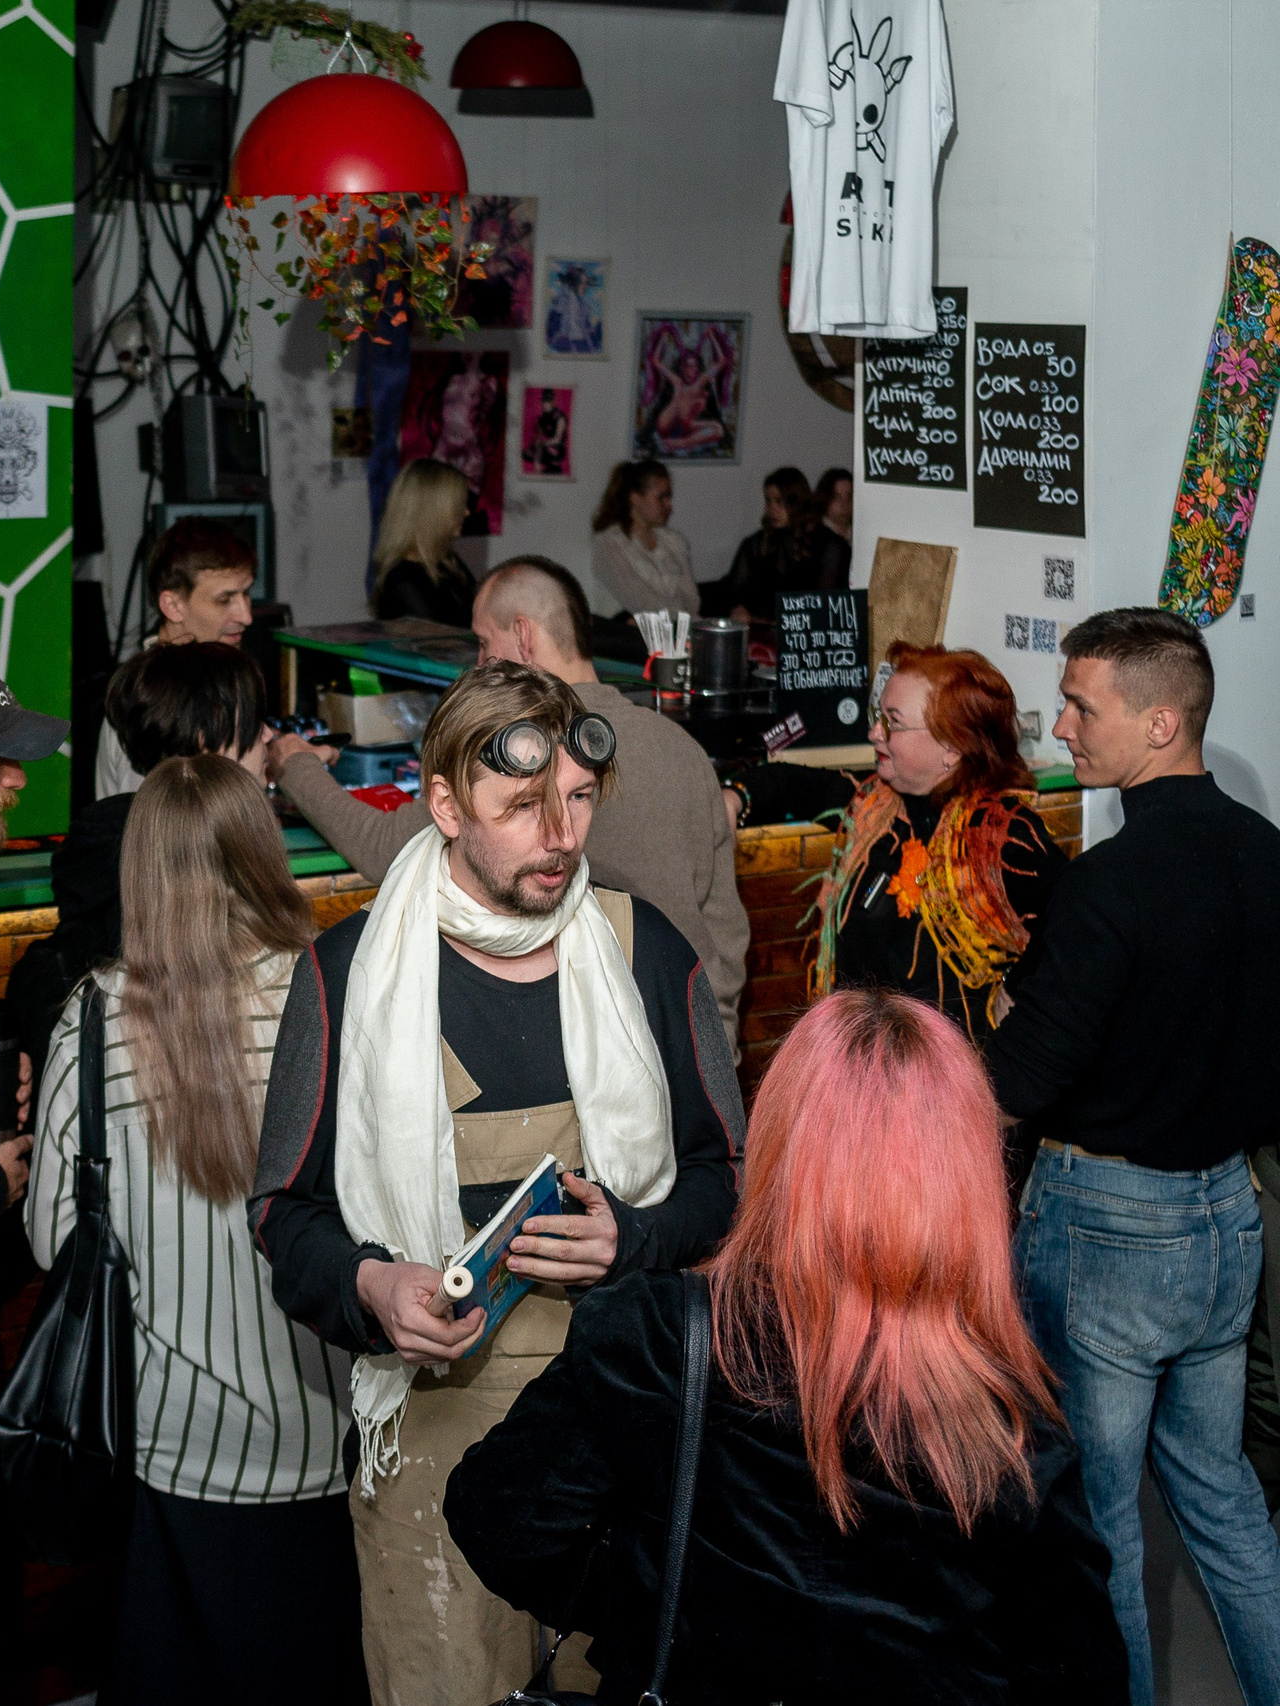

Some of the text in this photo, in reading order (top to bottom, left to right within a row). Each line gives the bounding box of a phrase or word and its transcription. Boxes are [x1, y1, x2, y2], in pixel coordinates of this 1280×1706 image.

[1046, 356, 1077, 378] 50
[922, 375, 955, 389] 200
[922, 405, 957, 421] 200
[1041, 395, 1079, 414] 100
[916, 426, 957, 444] 300
[1037, 430, 1080, 450] 200
[917, 464, 955, 483] 250
[1037, 484, 1079, 506] 200
[781, 613, 812, 632] ЗНАЕМ
[828, 595, 858, 632] МЫ
[785, 633, 808, 652] ЧТО
[810, 631, 826, 649] ЭТО
[781, 652, 800, 671] ЭТО
[802, 650, 821, 669] ЧТО
